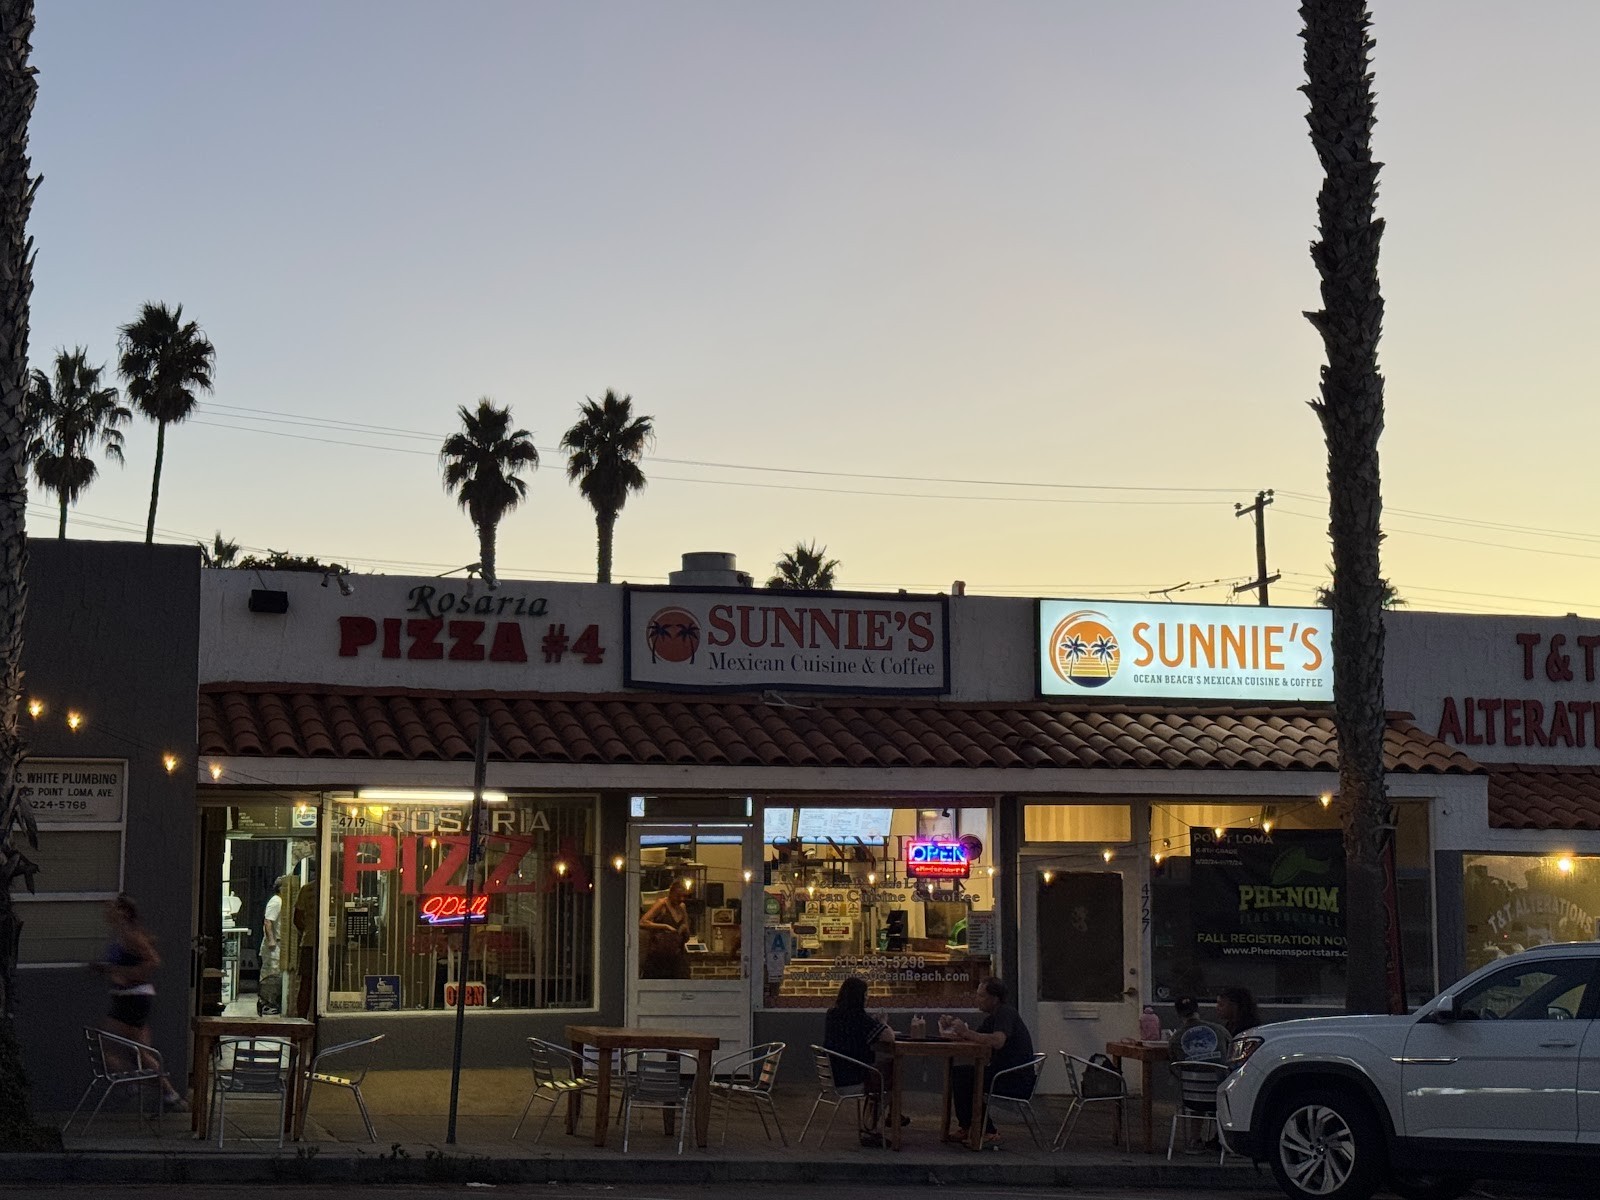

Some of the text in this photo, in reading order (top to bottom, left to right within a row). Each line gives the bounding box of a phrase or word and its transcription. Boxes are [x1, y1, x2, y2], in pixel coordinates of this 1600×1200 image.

[407, 584, 549, 619] Rosaria
[708, 604, 935, 653] SUNNIE'S
[337, 616, 606, 664] PIZZA #4
[1132, 621, 1322, 672] SUNNIE'S
[709, 652, 935, 675] Mexican Cuisine & Coffee
[1133, 674, 1323, 688] OCEAN BEACH'S MEXICAN CUISINE & COFFEE
[27, 773, 58, 784] WHITE
[62, 773, 117, 785] PLUMBING
[38, 787, 63, 796] POINT
[68, 788, 93, 797] LOMA
[339, 817, 365, 828] 4719
[1236, 834, 1274, 845] LOMA
[912, 846, 966, 862] OPEN
[1238, 884, 1340, 913] PHENOM
[771, 934, 785, 950] A
[1197, 933, 1228, 944] FALL
[1230, 933, 1321, 946] REGISTRATION
